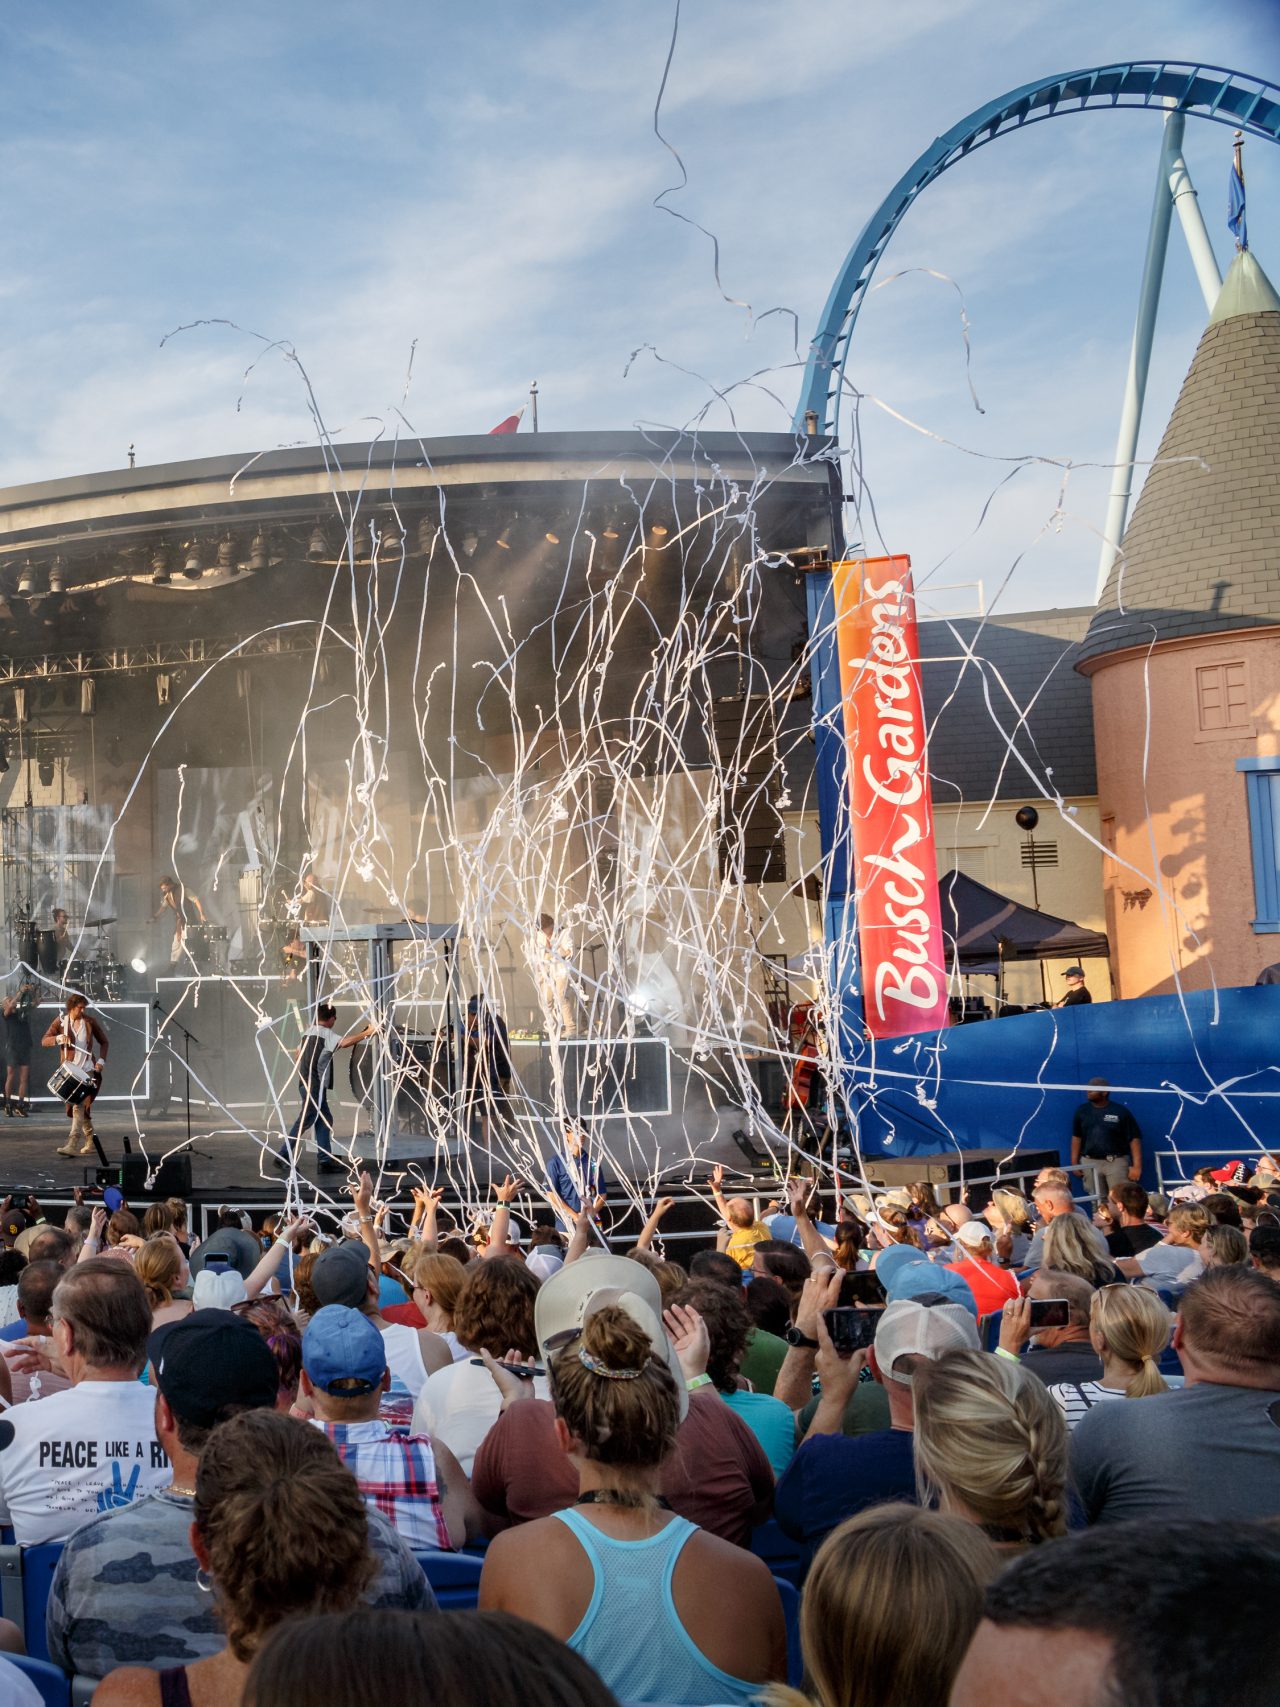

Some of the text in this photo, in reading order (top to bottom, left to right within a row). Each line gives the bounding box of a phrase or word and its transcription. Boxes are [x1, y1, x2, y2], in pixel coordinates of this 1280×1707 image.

[848, 578, 938, 1021] Busch Gardens
[39, 1441, 173, 1468] PEACE LIKE A RI
